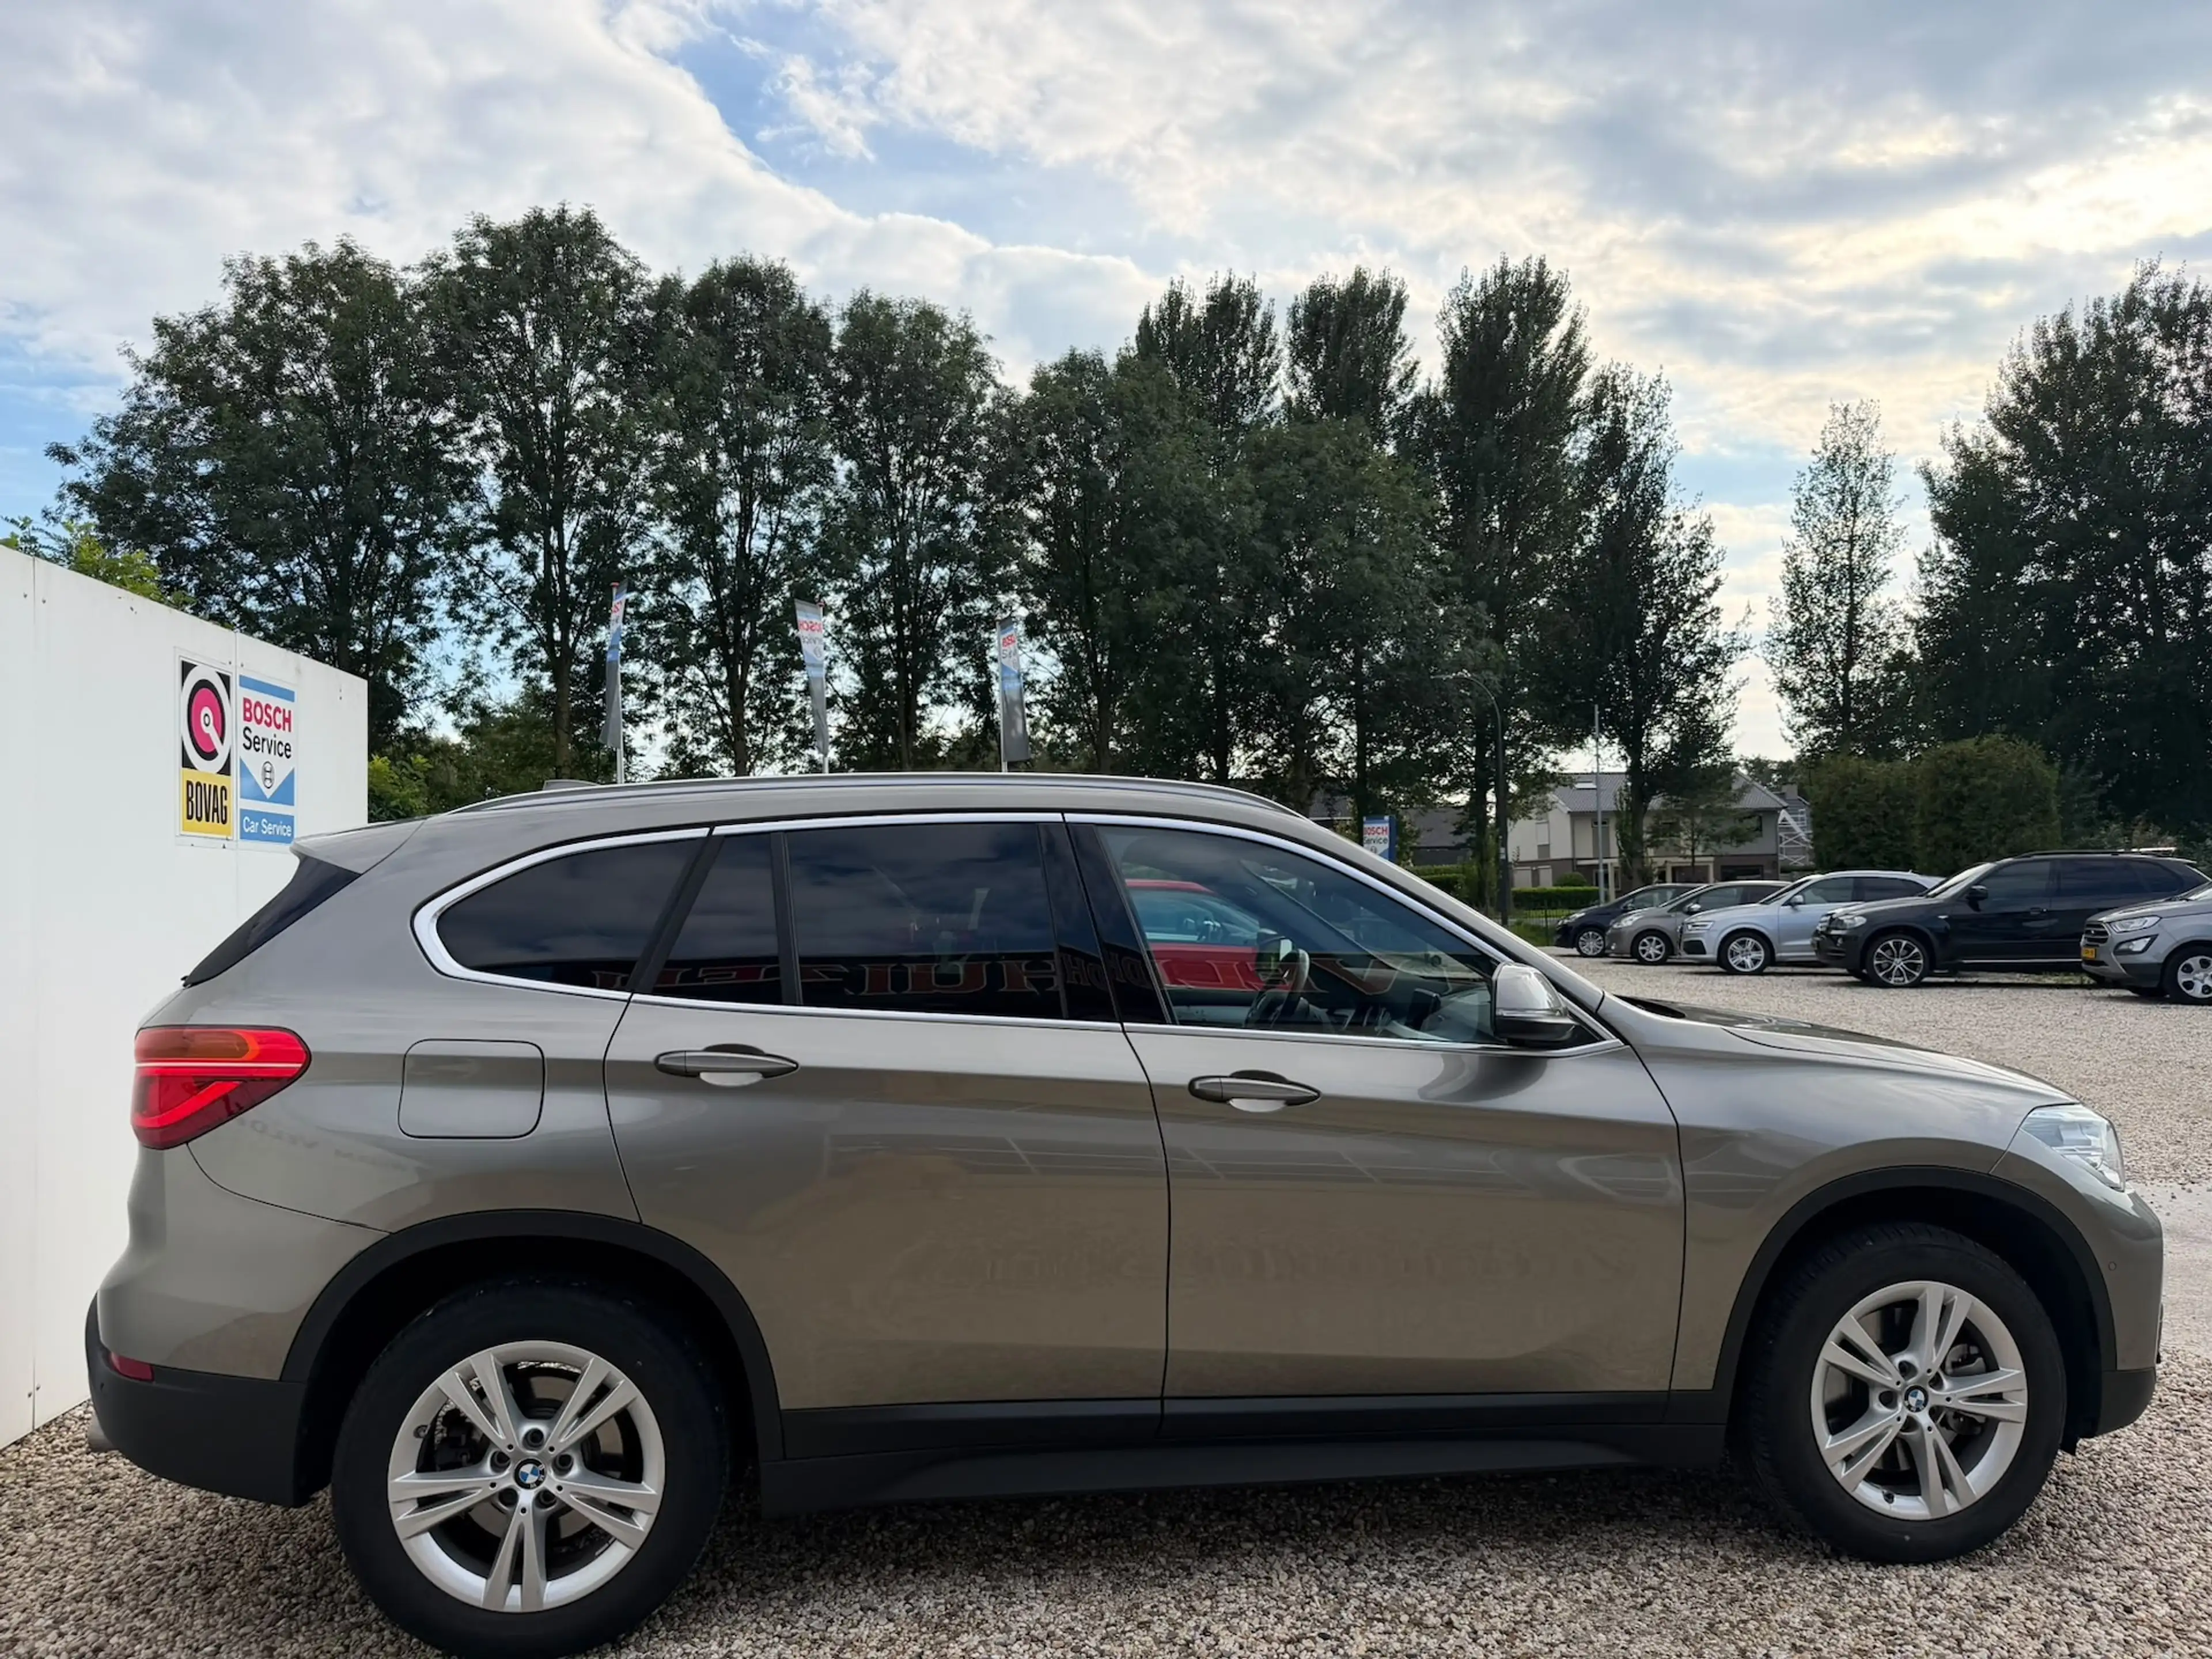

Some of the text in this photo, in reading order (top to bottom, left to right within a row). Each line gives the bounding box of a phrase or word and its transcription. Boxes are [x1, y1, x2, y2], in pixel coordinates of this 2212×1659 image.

[243, 697, 292, 732] BOSCH
[243, 726, 292, 759] Service
[186, 780, 228, 824] BOVAG
[243, 816, 292, 836] Car Service
[1363, 827, 1388, 835] BOSCH
